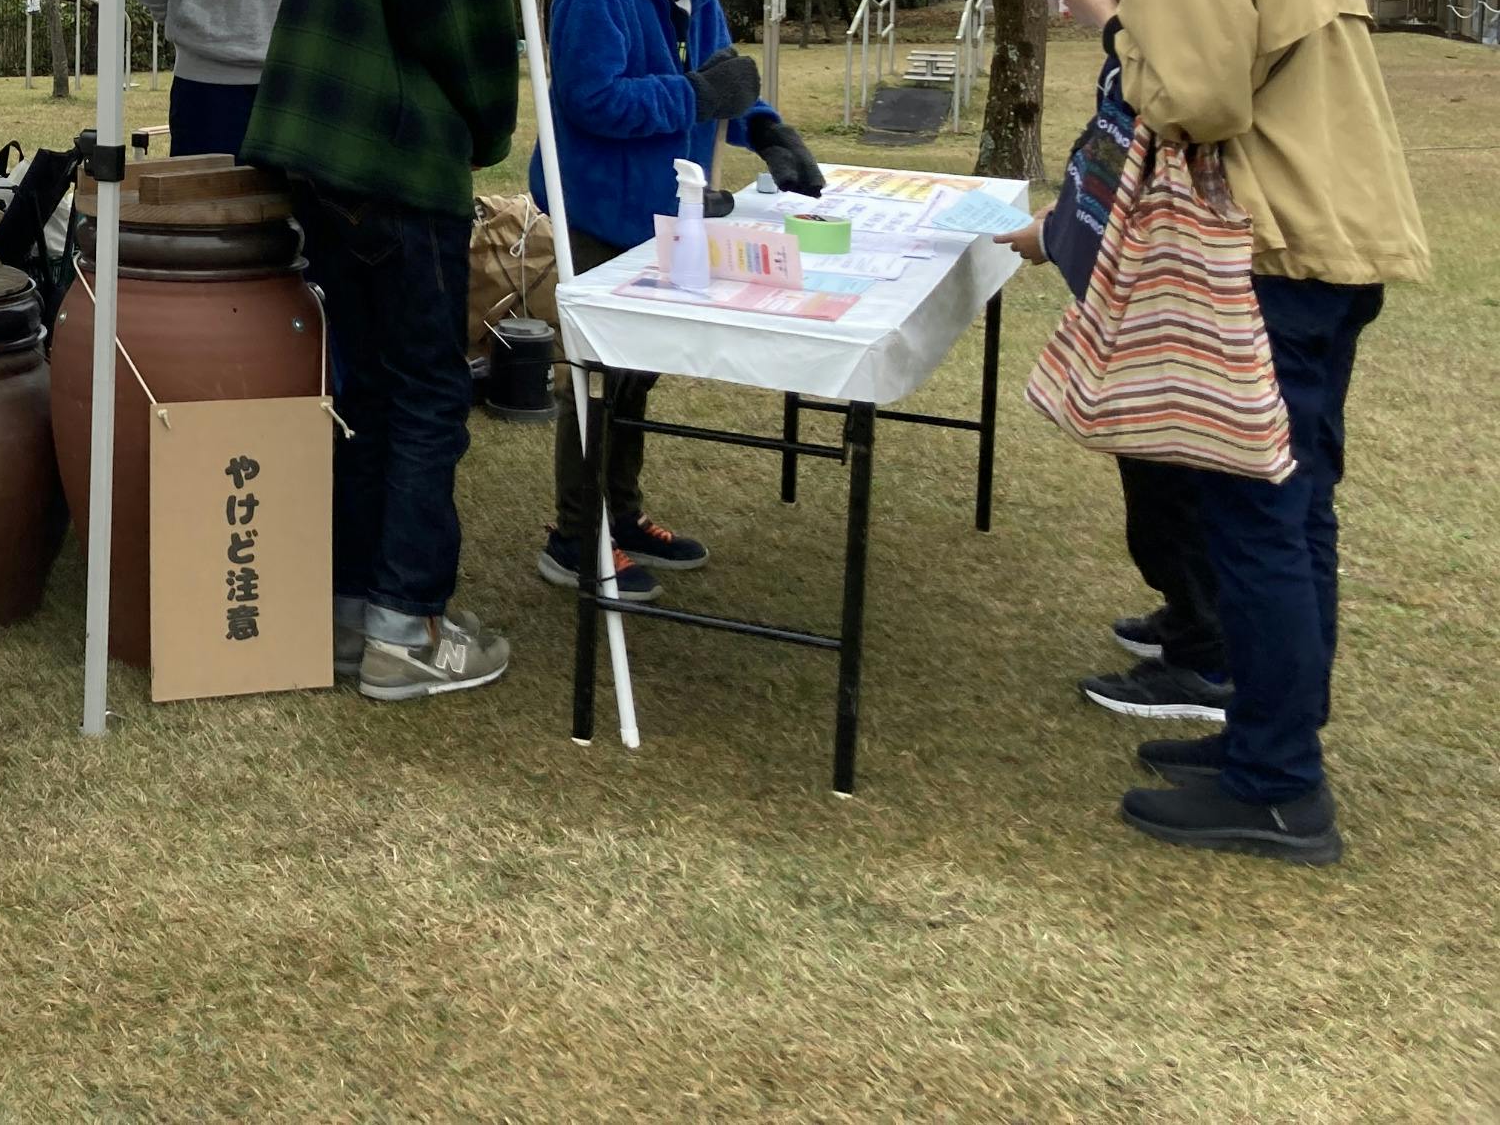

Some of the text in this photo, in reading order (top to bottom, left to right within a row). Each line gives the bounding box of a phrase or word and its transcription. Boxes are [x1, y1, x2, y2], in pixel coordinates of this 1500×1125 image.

[224, 455, 260, 641] やけど注意
[434, 639, 466, 674] N
